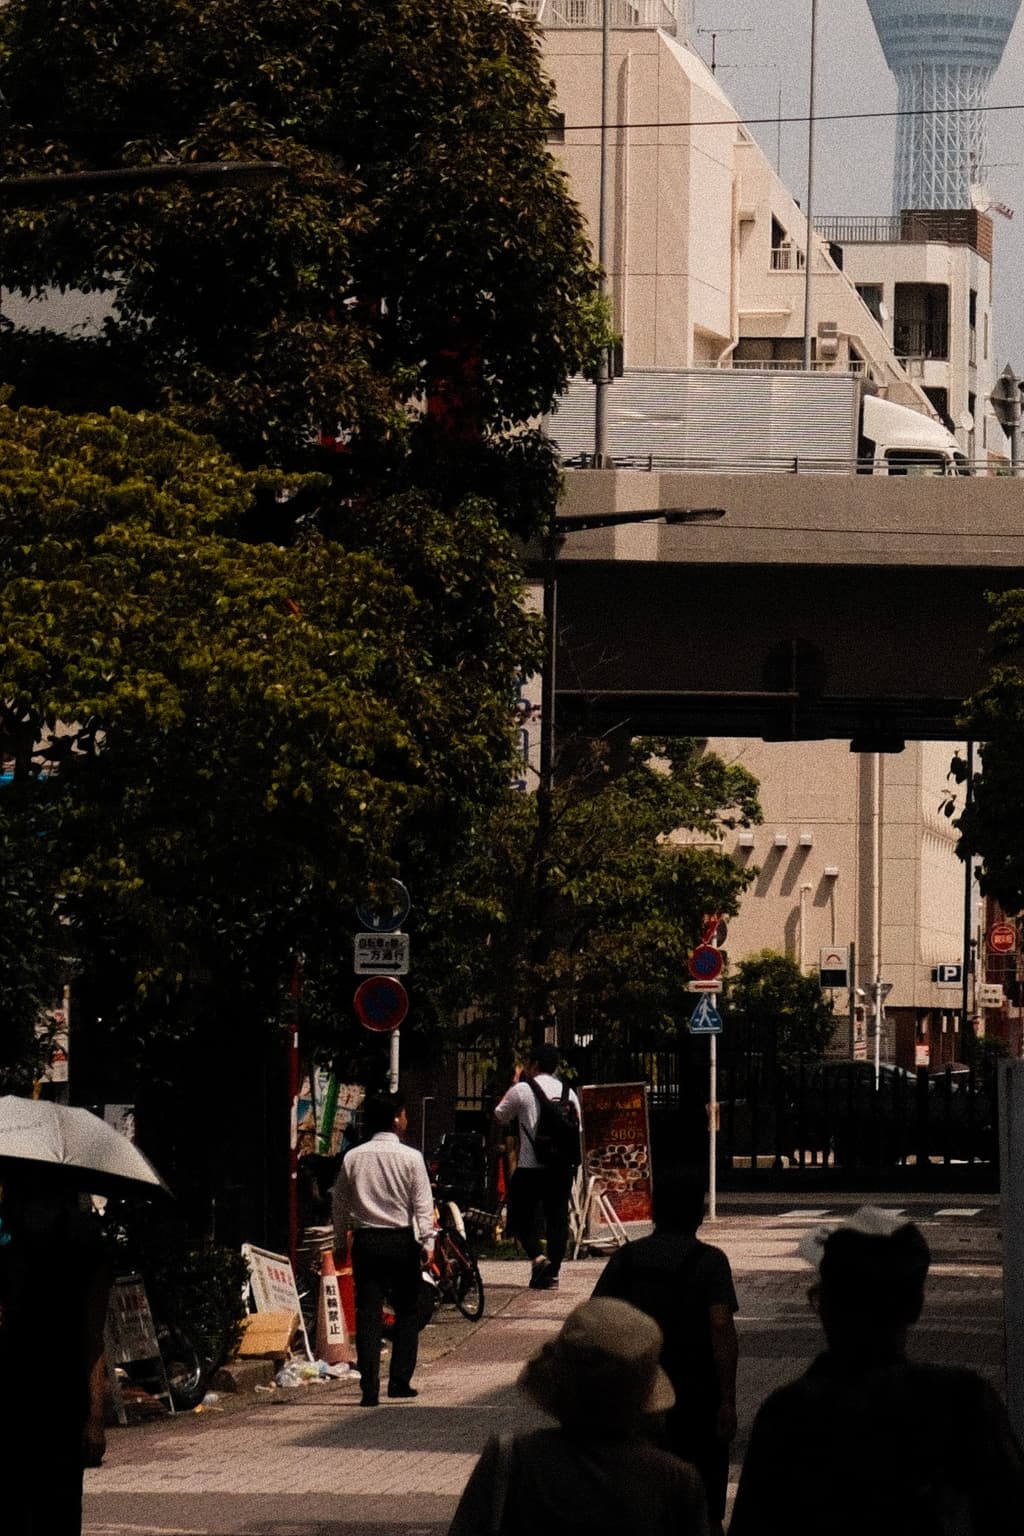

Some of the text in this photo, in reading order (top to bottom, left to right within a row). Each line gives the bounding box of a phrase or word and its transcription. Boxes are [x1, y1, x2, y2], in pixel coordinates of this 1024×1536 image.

[359, 950, 405, 961] 一方通行
[943, 966, 958, 982] P
